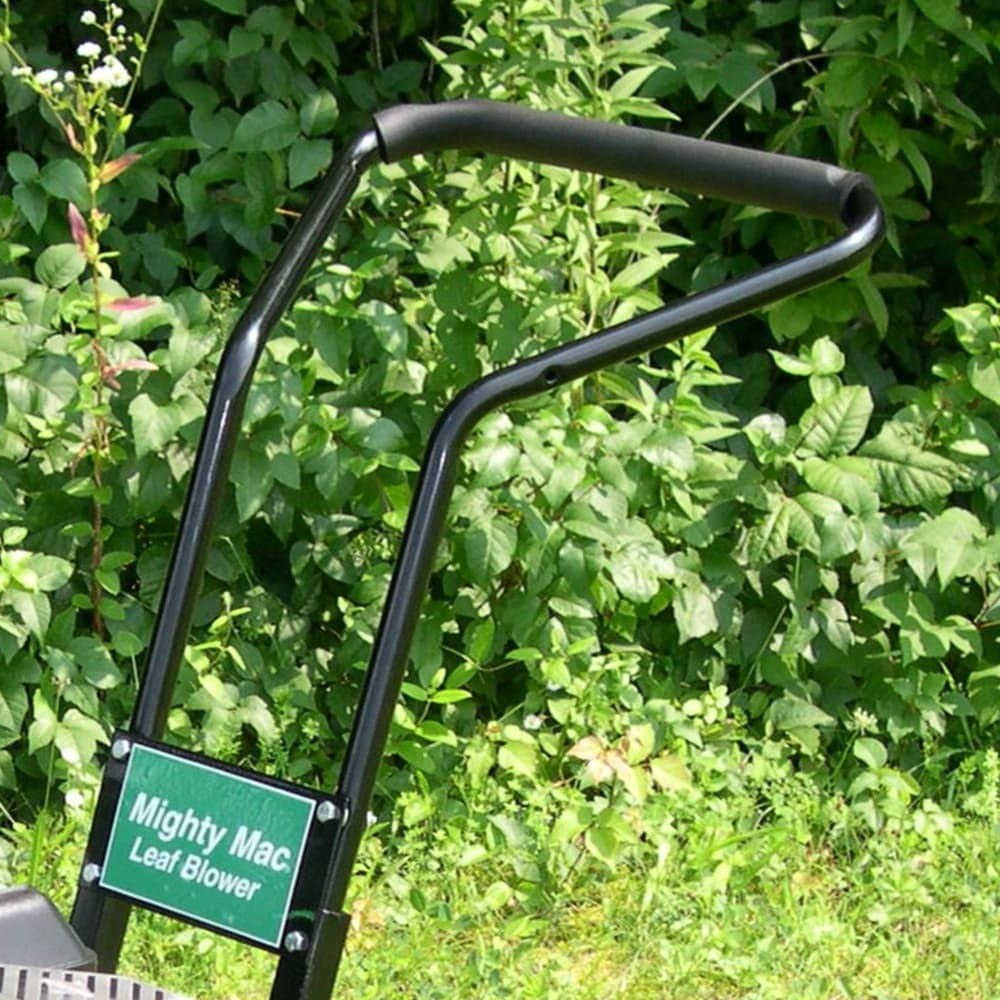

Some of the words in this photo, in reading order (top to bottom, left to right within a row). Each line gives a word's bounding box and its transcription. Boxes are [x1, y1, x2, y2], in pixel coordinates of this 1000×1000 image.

[129, 792, 227, 854] Mighty
[229, 826, 291, 872] Mac
[129, 837, 182, 873] Leaf
[181, 854, 261, 901] Blower
